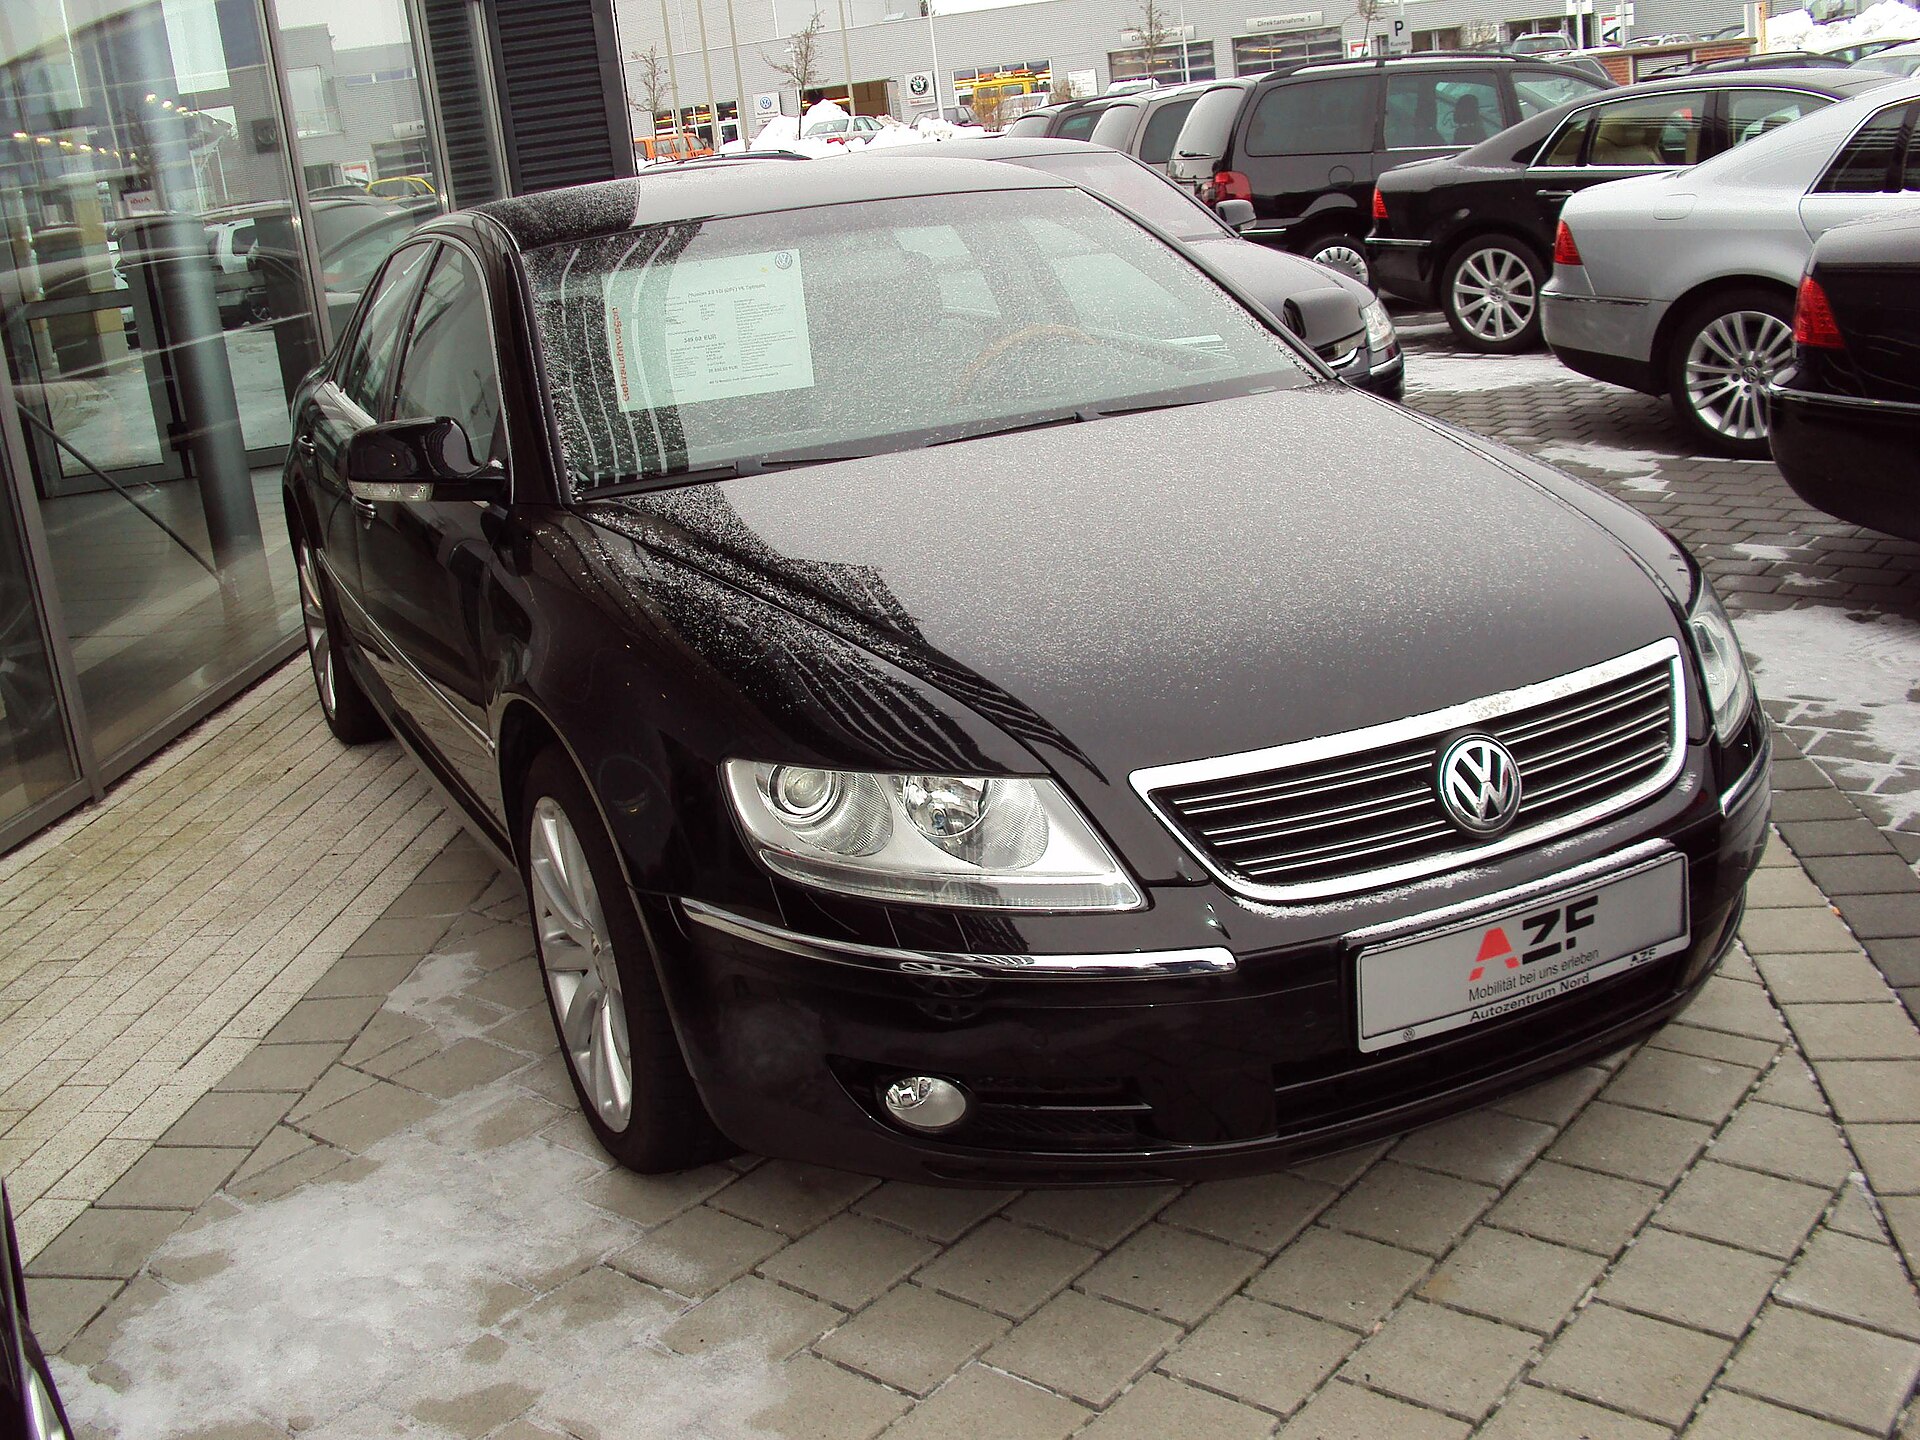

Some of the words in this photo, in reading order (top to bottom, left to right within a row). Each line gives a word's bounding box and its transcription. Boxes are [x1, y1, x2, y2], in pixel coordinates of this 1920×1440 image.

[1257, 17, 1305, 27] Direktannahme
[1394, 20, 1404, 37] P
[612, 305, 631, 402] Gebrauchtwagen
[1468, 894, 1599, 982] AZF
[1468, 977, 1517, 1002] Mobilität
[1519, 970, 1537, 987] bei
[1538, 963, 1560, 980] uns
[1561, 950, 1600, 972] erleben
[1469, 987, 1557, 1022] Autozentrum
[1559, 973, 1590, 992] Nord
